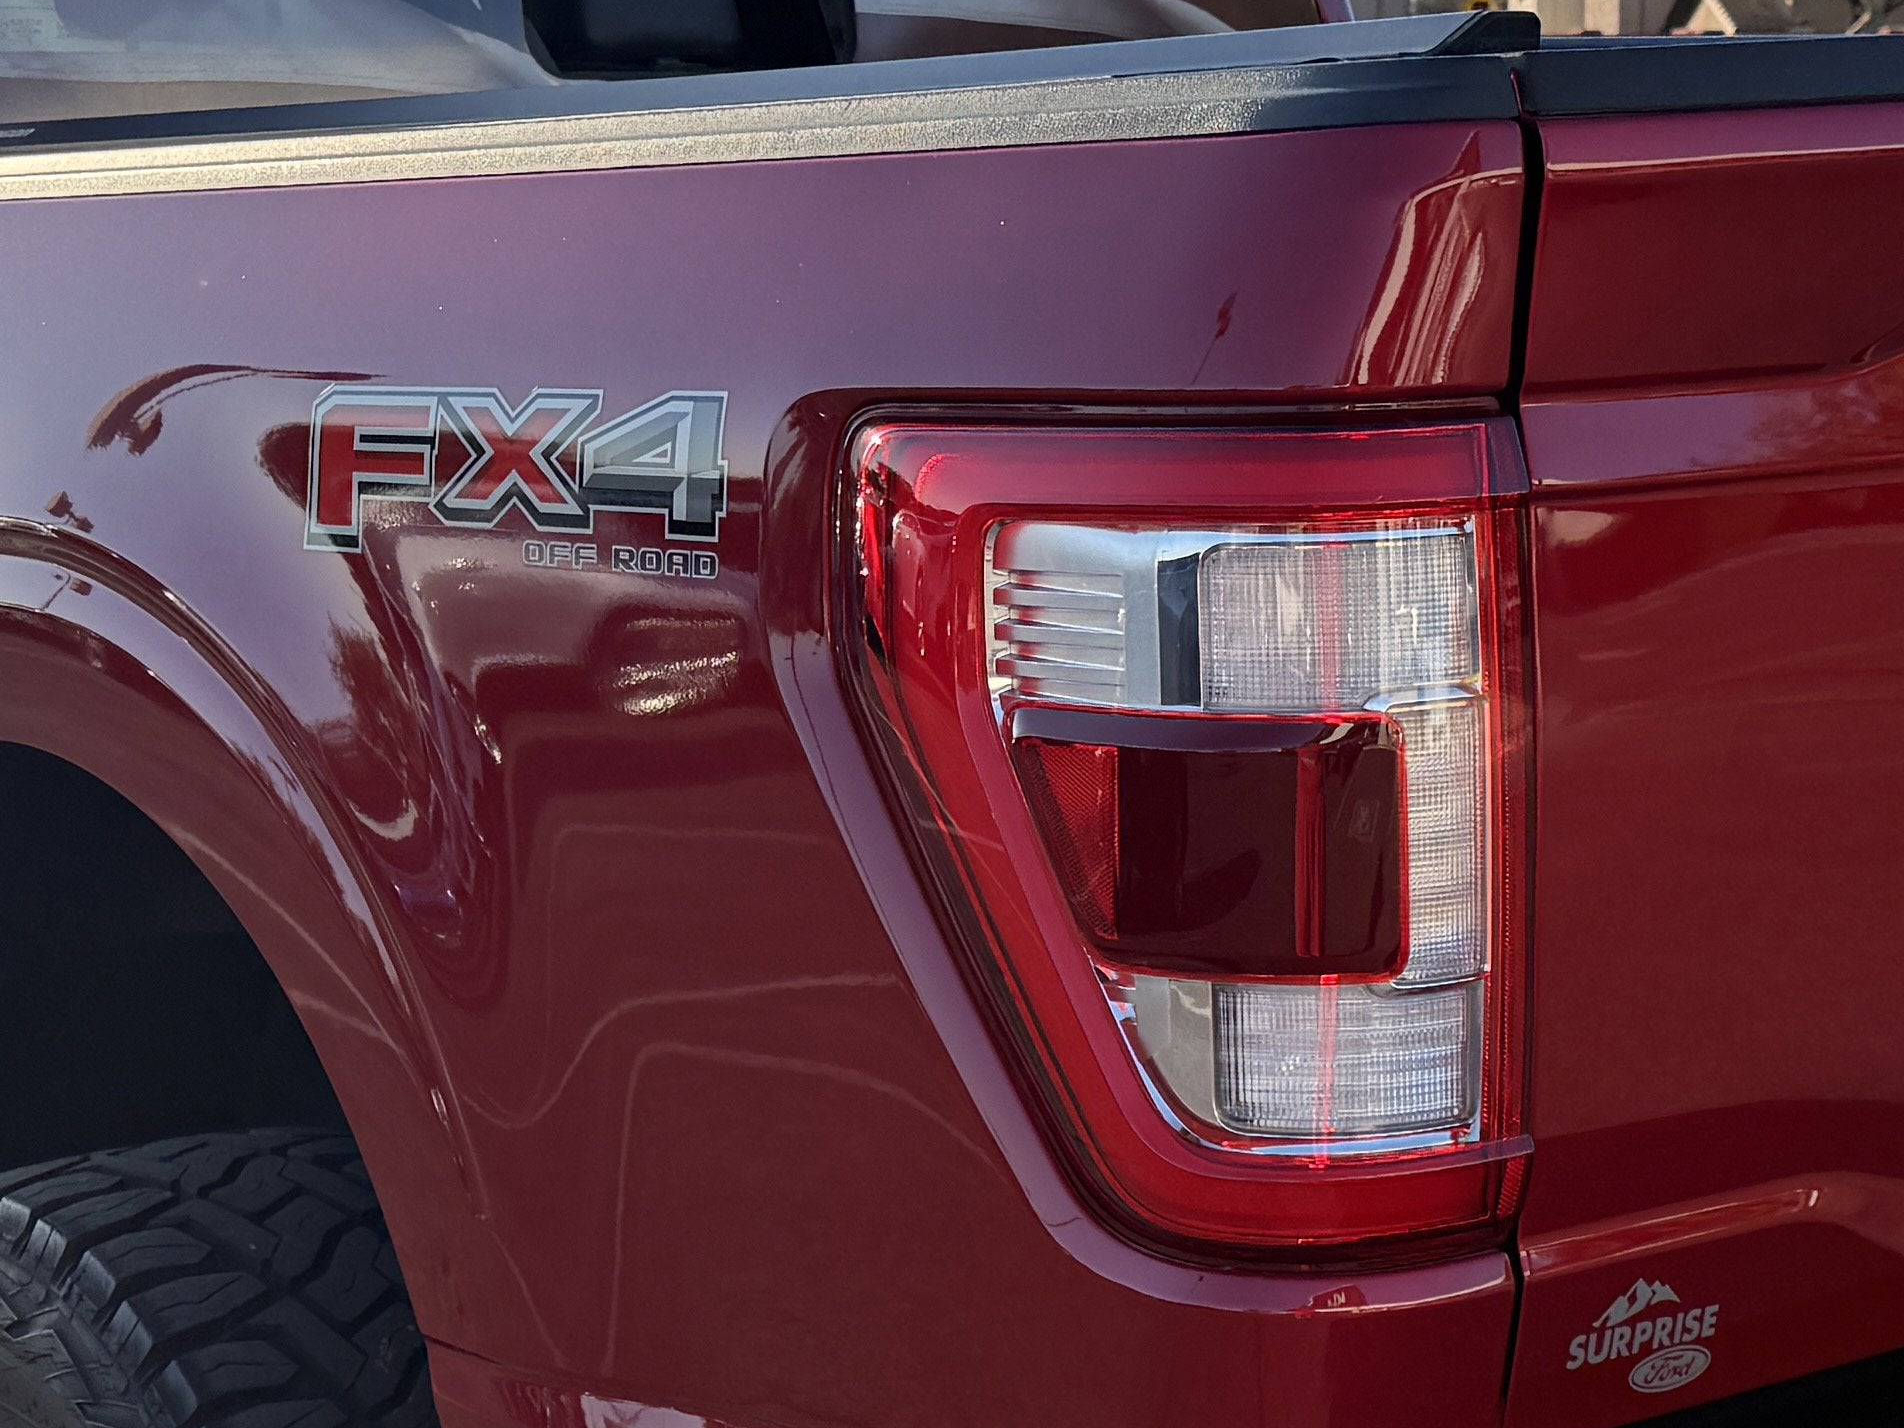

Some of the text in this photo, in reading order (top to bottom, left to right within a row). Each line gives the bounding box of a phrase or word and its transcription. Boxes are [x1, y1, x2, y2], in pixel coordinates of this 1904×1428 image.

[303, 383, 728, 553] FX4
[523, 540, 720, 580] OFF ROAD
[1566, 1303, 1720, 1371] SURPRISE
[1643, 1353, 1698, 1385] Ford
